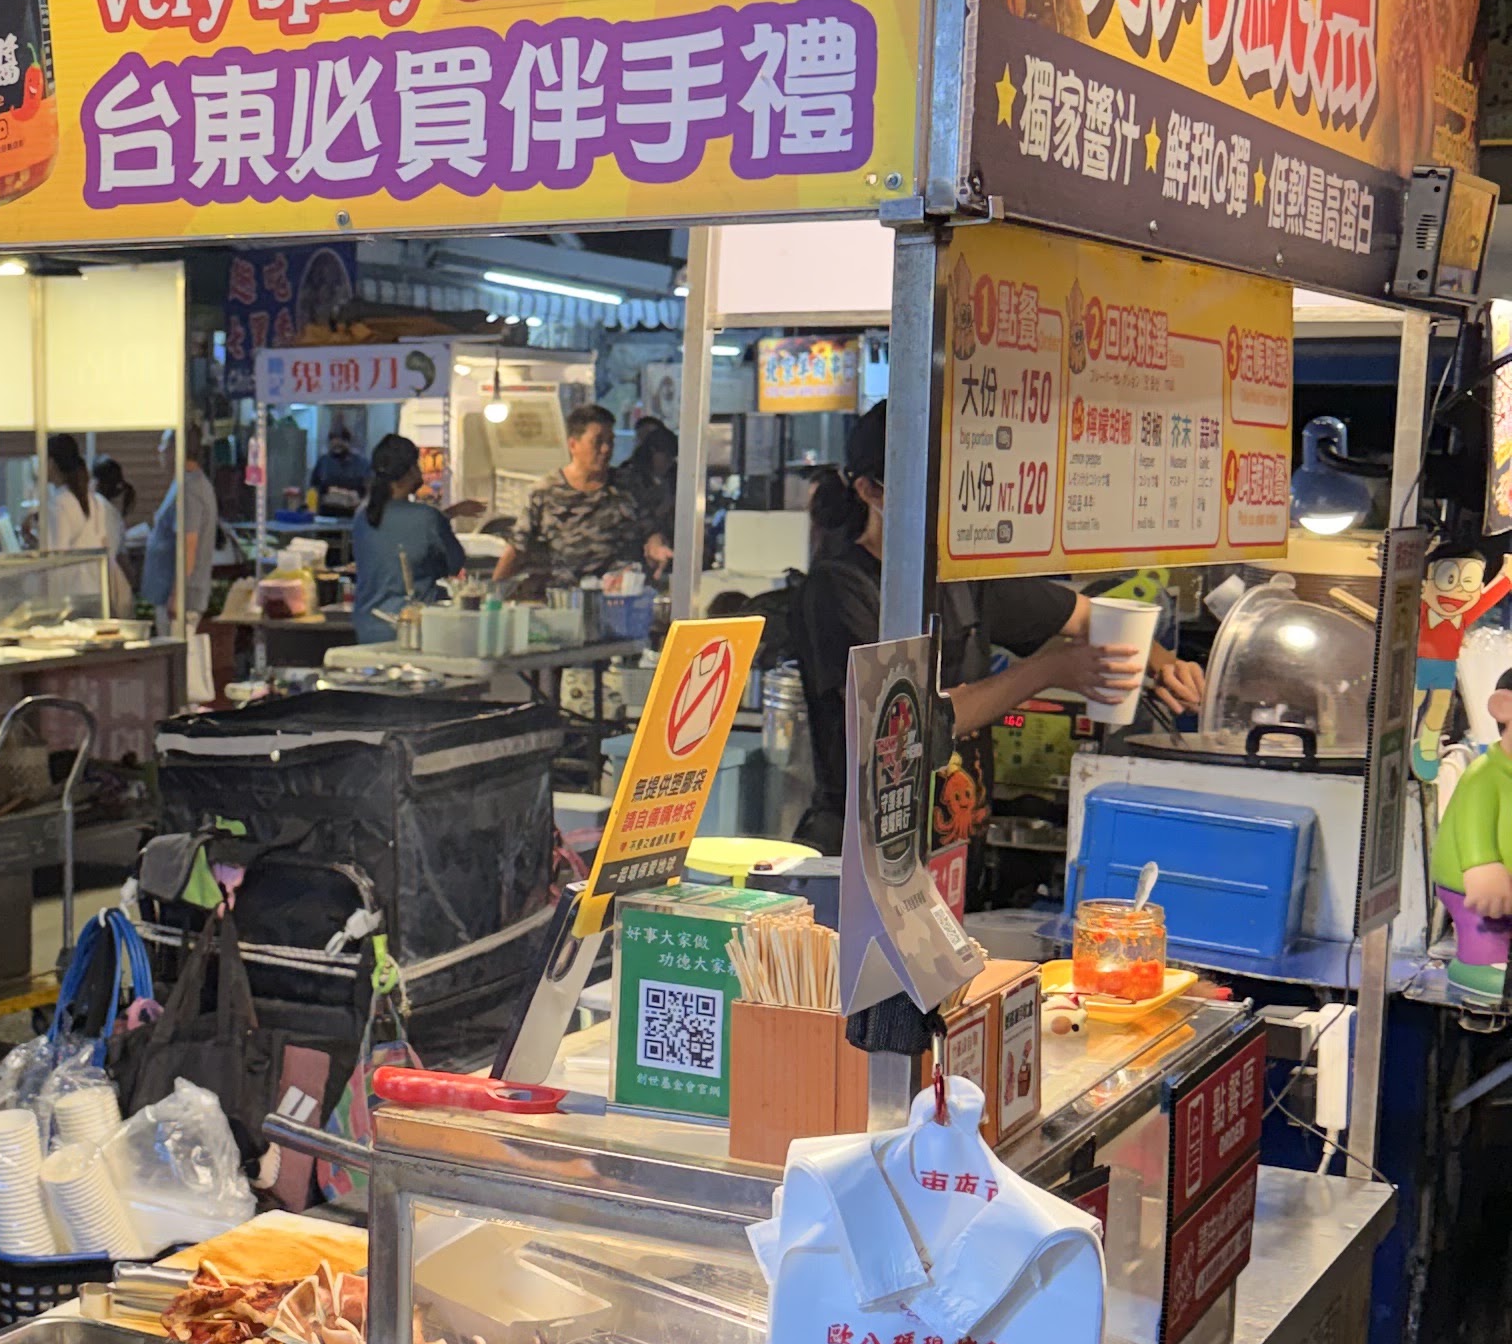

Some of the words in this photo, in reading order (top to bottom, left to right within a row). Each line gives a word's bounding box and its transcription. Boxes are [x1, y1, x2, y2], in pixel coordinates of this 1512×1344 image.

[95, 20, 861, 197] 台東必買伴手禮
[1019, 56, 1140, 186] 獨家醬汁
[1162, 108, 1251, 219] 鮮甜Q彈
[1267, 151, 1376, 255] 低熱量高蛋白
[996, 280, 1039, 352] 點餐
[960, 364, 998, 418] 大份
[1170, 413, 1193, 449] 芥末
[958, 460, 995, 513] 小份
[625, 924, 711, 951] 好事大家做
[636, 1072, 722, 1098] 創世基金會官網
